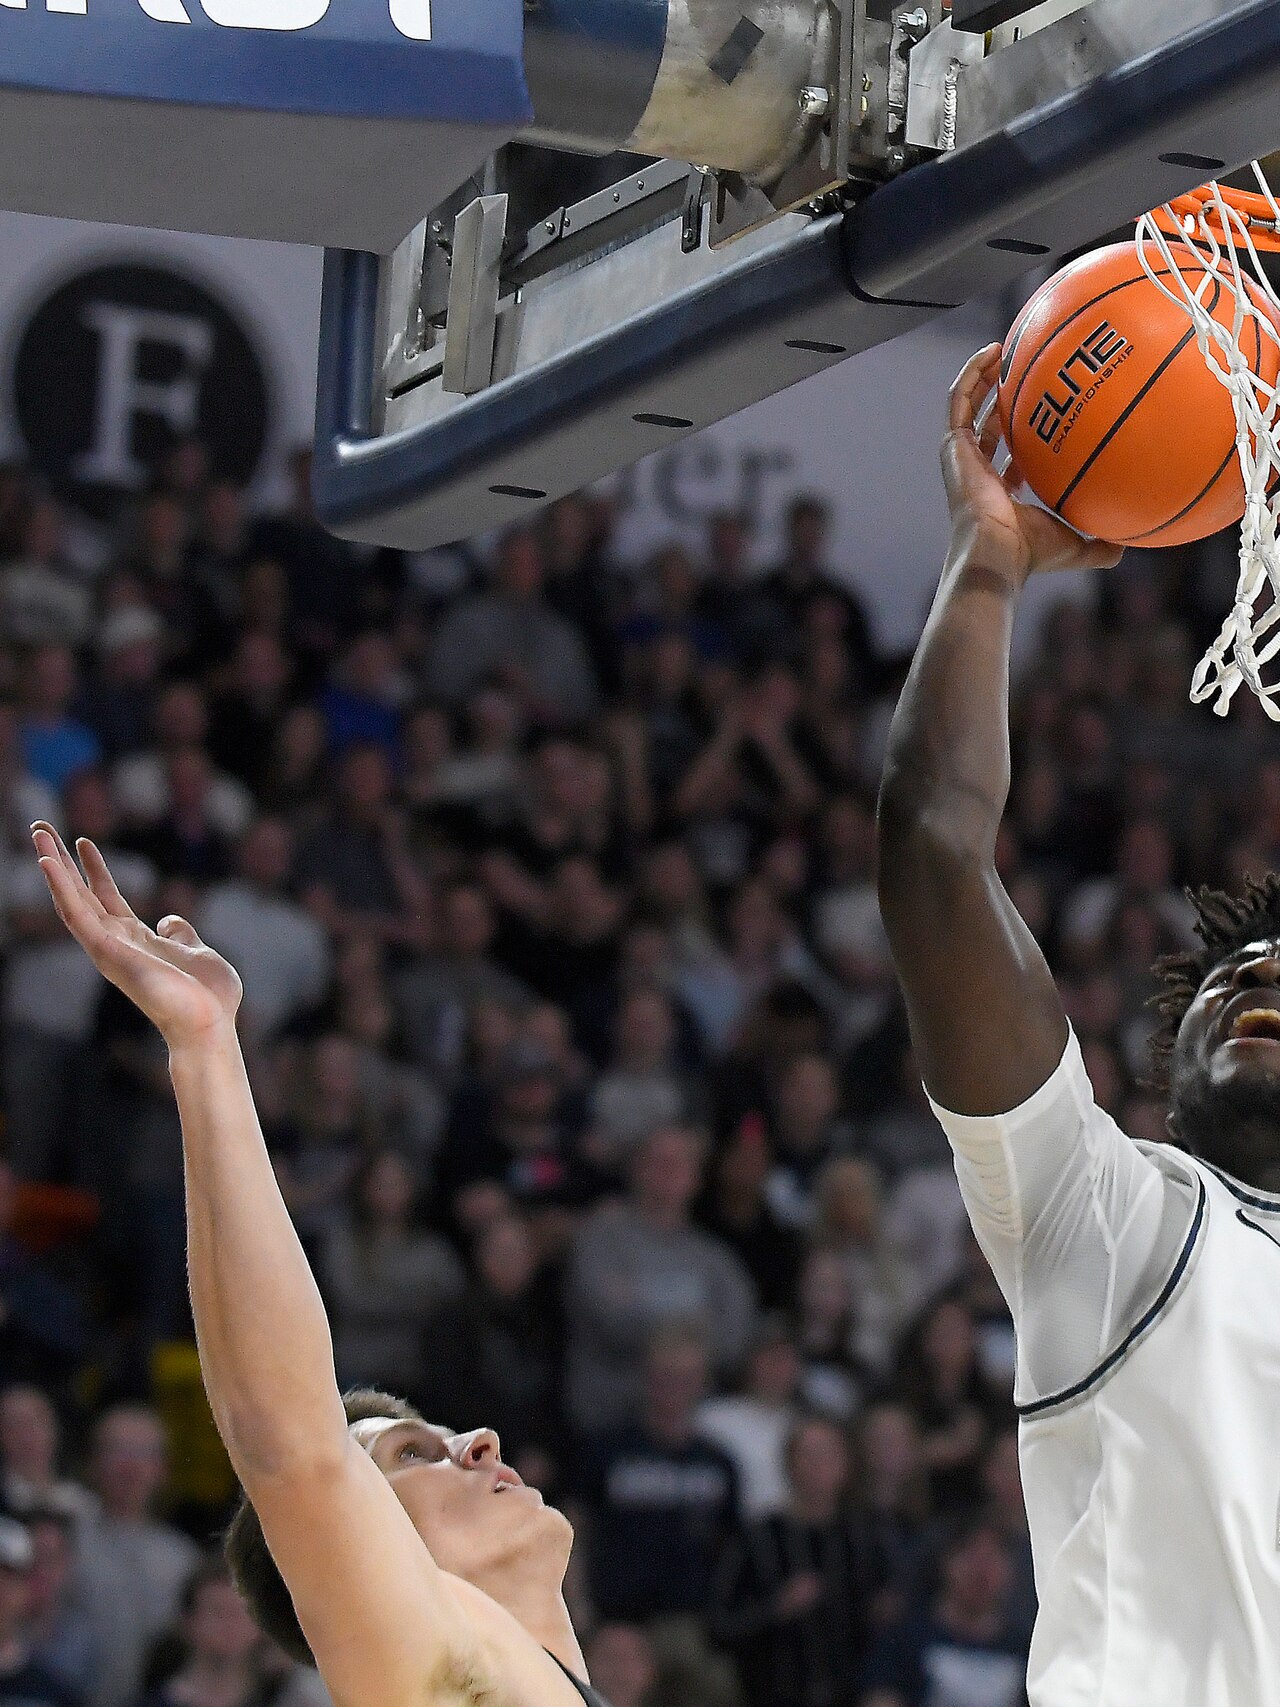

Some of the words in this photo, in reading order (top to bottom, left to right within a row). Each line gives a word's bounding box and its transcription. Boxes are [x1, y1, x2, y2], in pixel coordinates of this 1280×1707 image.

[78, 306, 214, 487] F
[1029, 319, 1128, 445] ELITE
[1052, 344, 1135, 454] CHAMPIONSHIP
